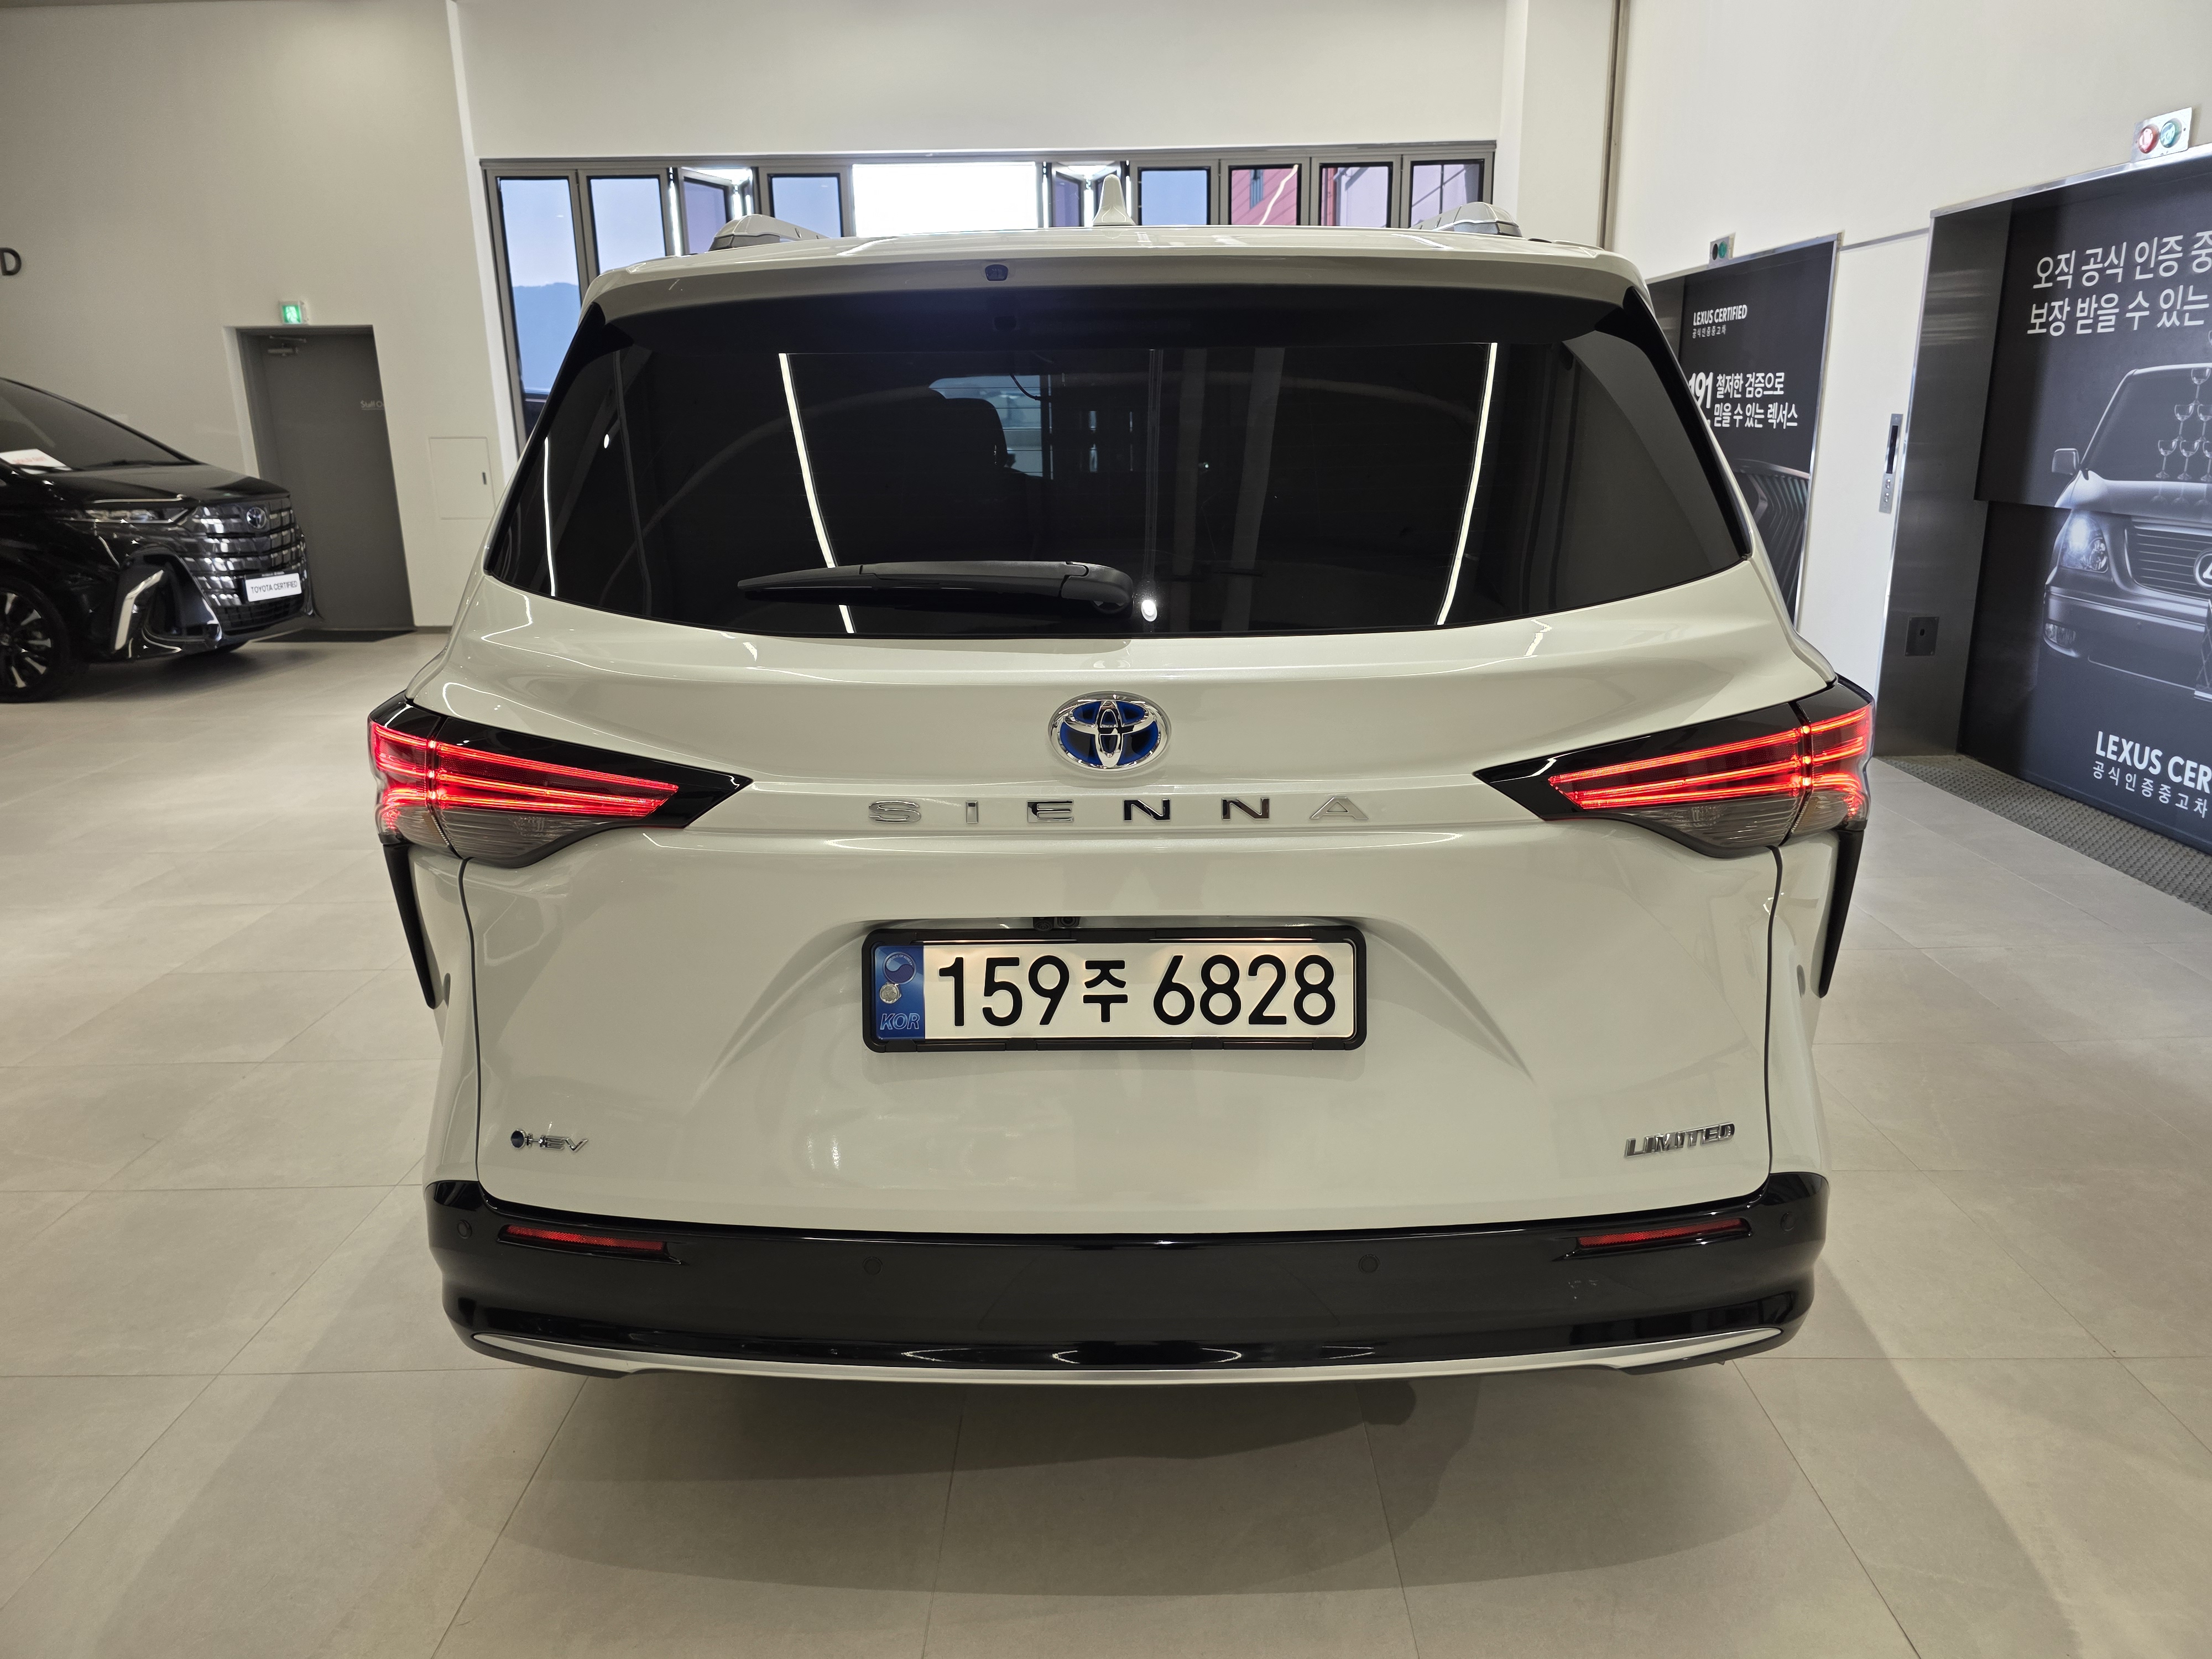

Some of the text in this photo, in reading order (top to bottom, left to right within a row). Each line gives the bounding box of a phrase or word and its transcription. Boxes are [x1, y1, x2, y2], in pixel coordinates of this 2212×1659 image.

[2032, 250, 2075, 289] 오직
[2081, 242, 2127, 286] 공식
[2135, 235, 2184, 280] 인증
[1693, 304, 1747, 326] LEXUS CERTIFIED
[2027, 285, 2209, 337] 보장 받을 수 있는
[1717, 372, 1743, 398] 철저한
[1745, 372, 1785, 398] 검증으로
[1714, 402, 1798, 429] 믿을 수 있는 렉서스
[251, 581, 298, 593] TOYOTA CERTIFIED
[2096, 731, 2163, 775] LEXUS
[868, 796, 1369, 824] SIENNA
[1153, 954, 1337, 1027] 6828
[880, 1013, 920, 1030] KOR
[1625, 1121, 1735, 1157] LIMITED
